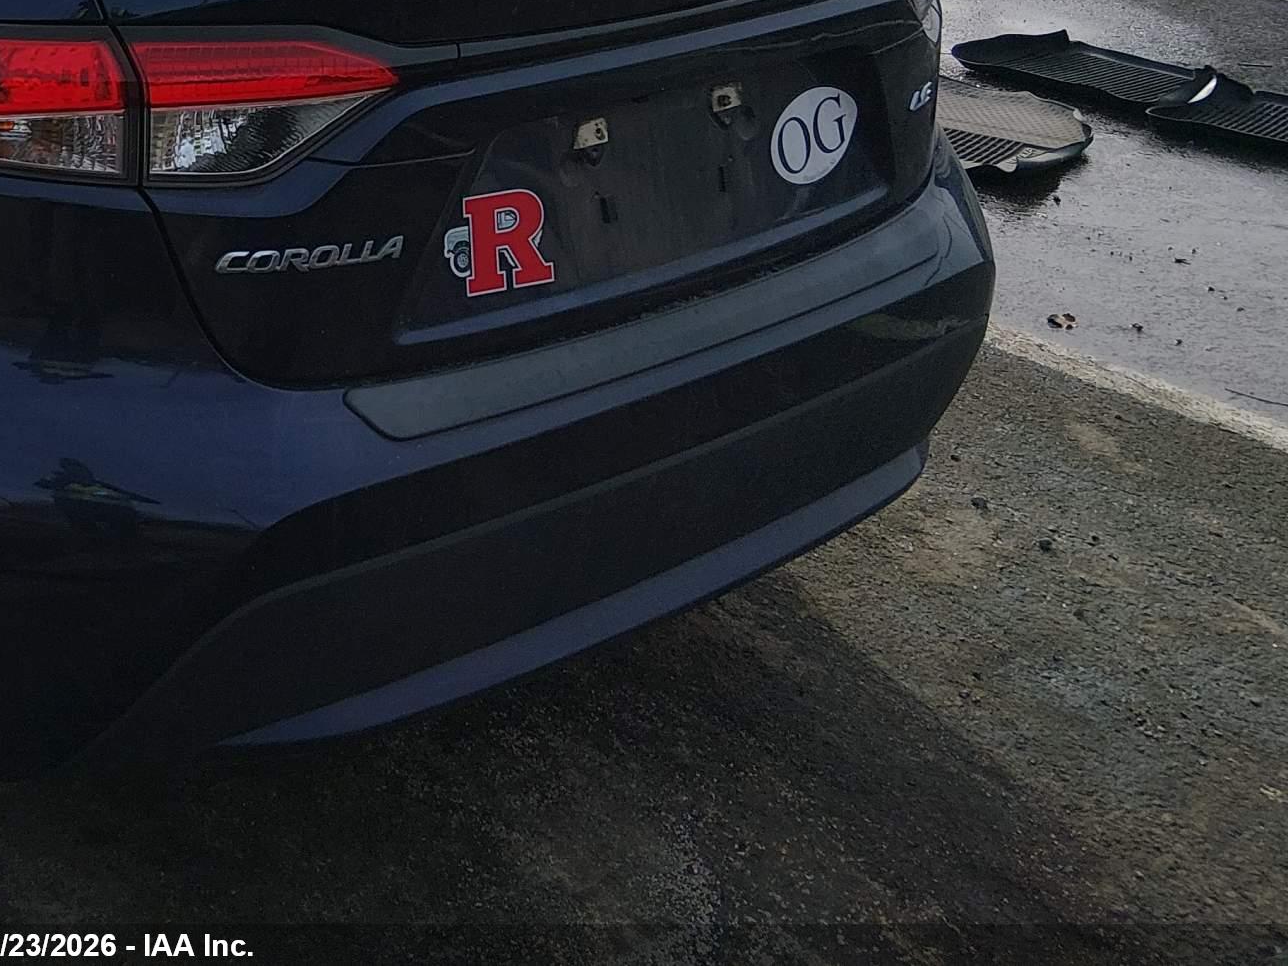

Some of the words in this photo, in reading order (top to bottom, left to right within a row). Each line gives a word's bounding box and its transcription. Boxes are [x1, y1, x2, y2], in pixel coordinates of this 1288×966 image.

[778, 92, 847, 174] OG
[215, 235, 404, 274] COROLLA
[463, 188, 555, 298] R
